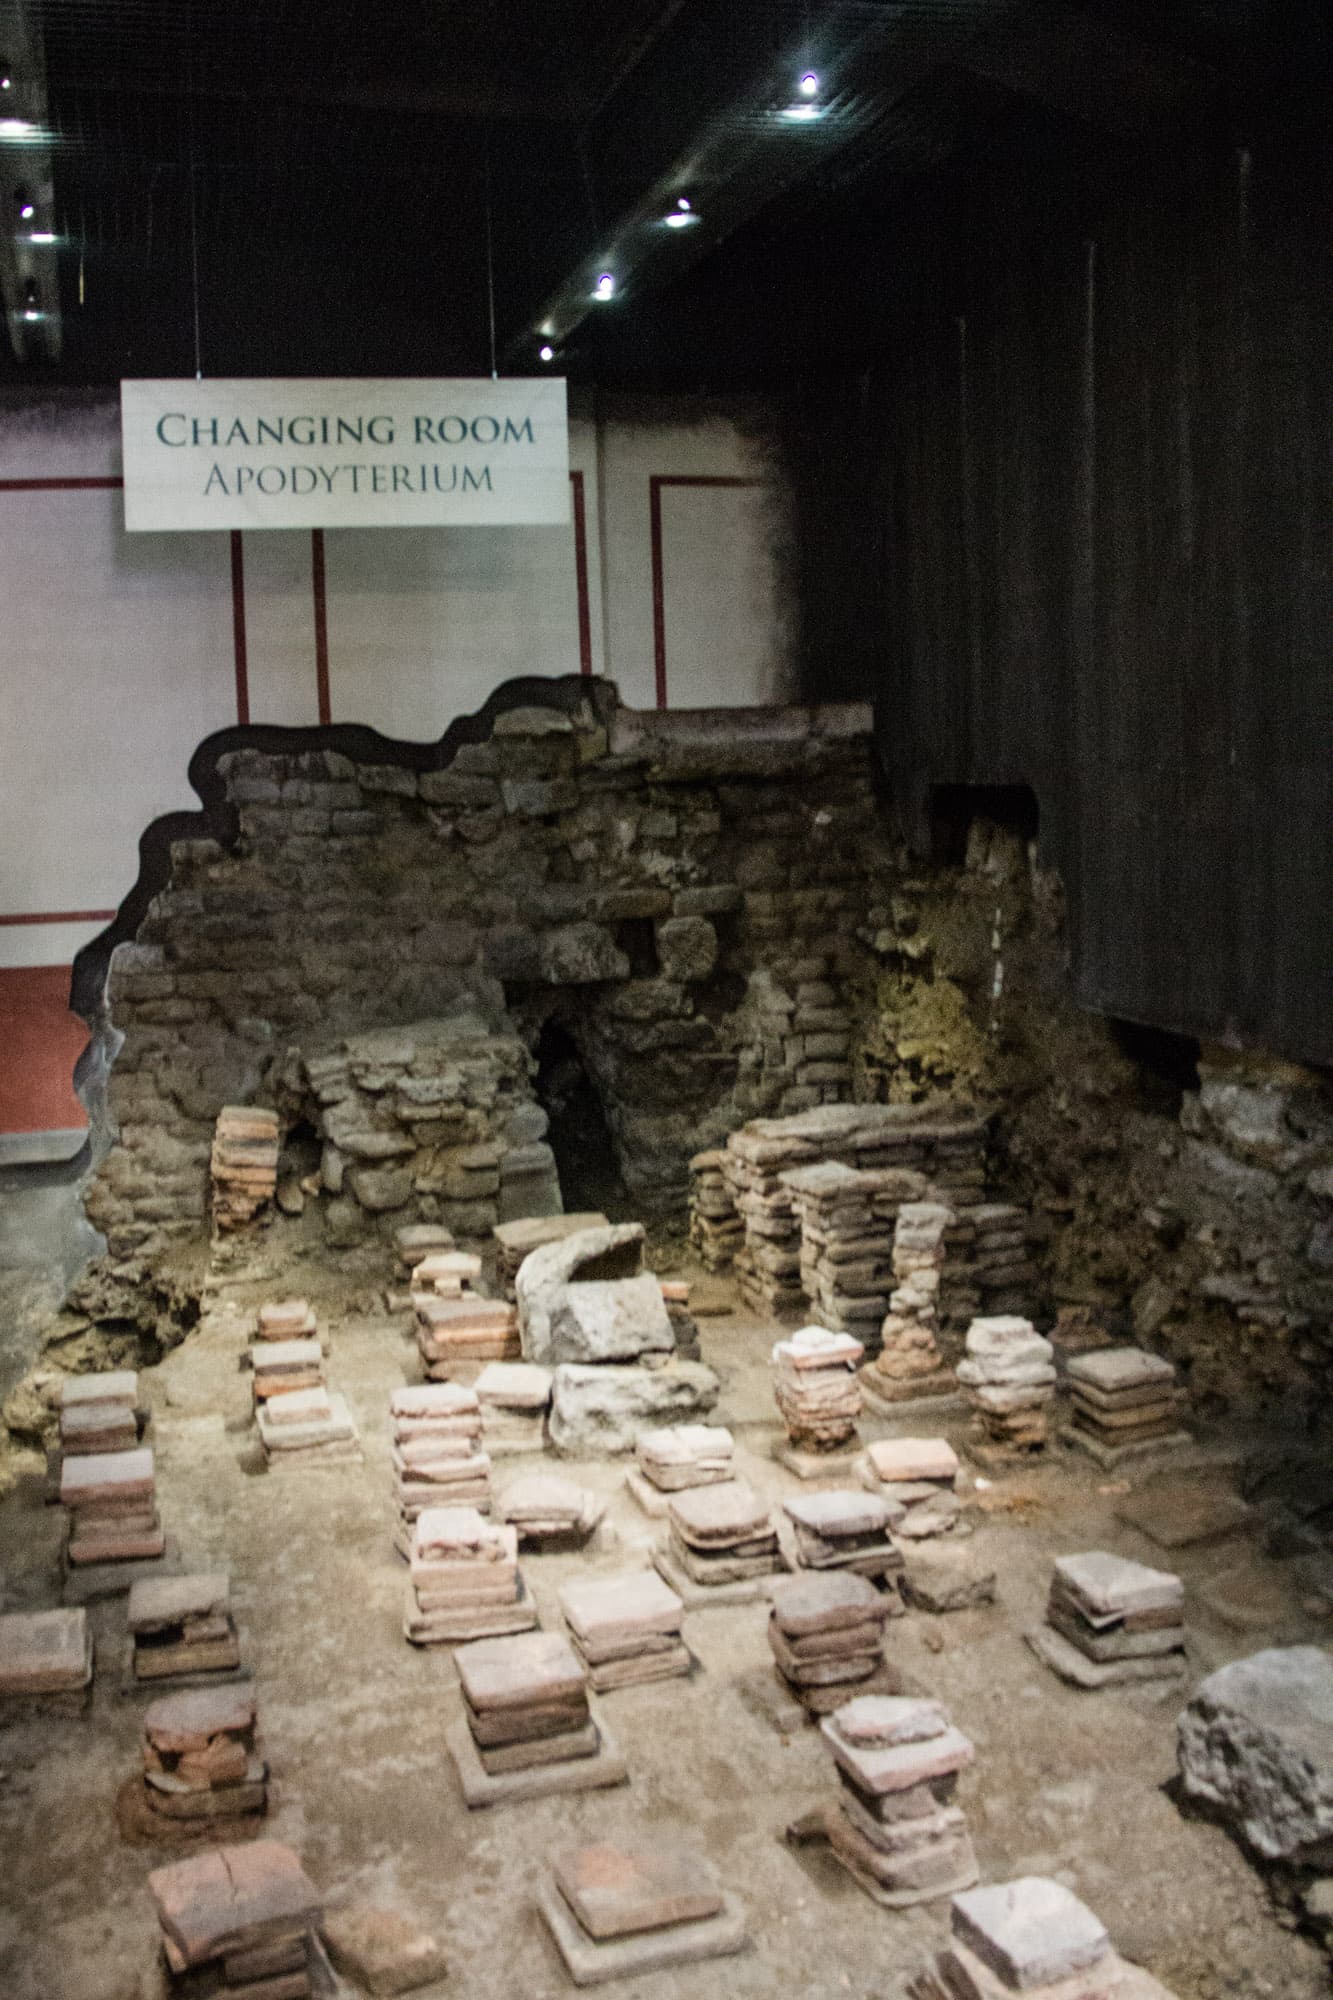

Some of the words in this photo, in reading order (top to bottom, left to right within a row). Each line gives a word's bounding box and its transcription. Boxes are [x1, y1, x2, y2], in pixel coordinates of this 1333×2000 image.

[156, 413, 395, 447] CHANGING
[414, 415, 535, 443] ROOM
[203, 463, 493, 495] APODYTERIUM
